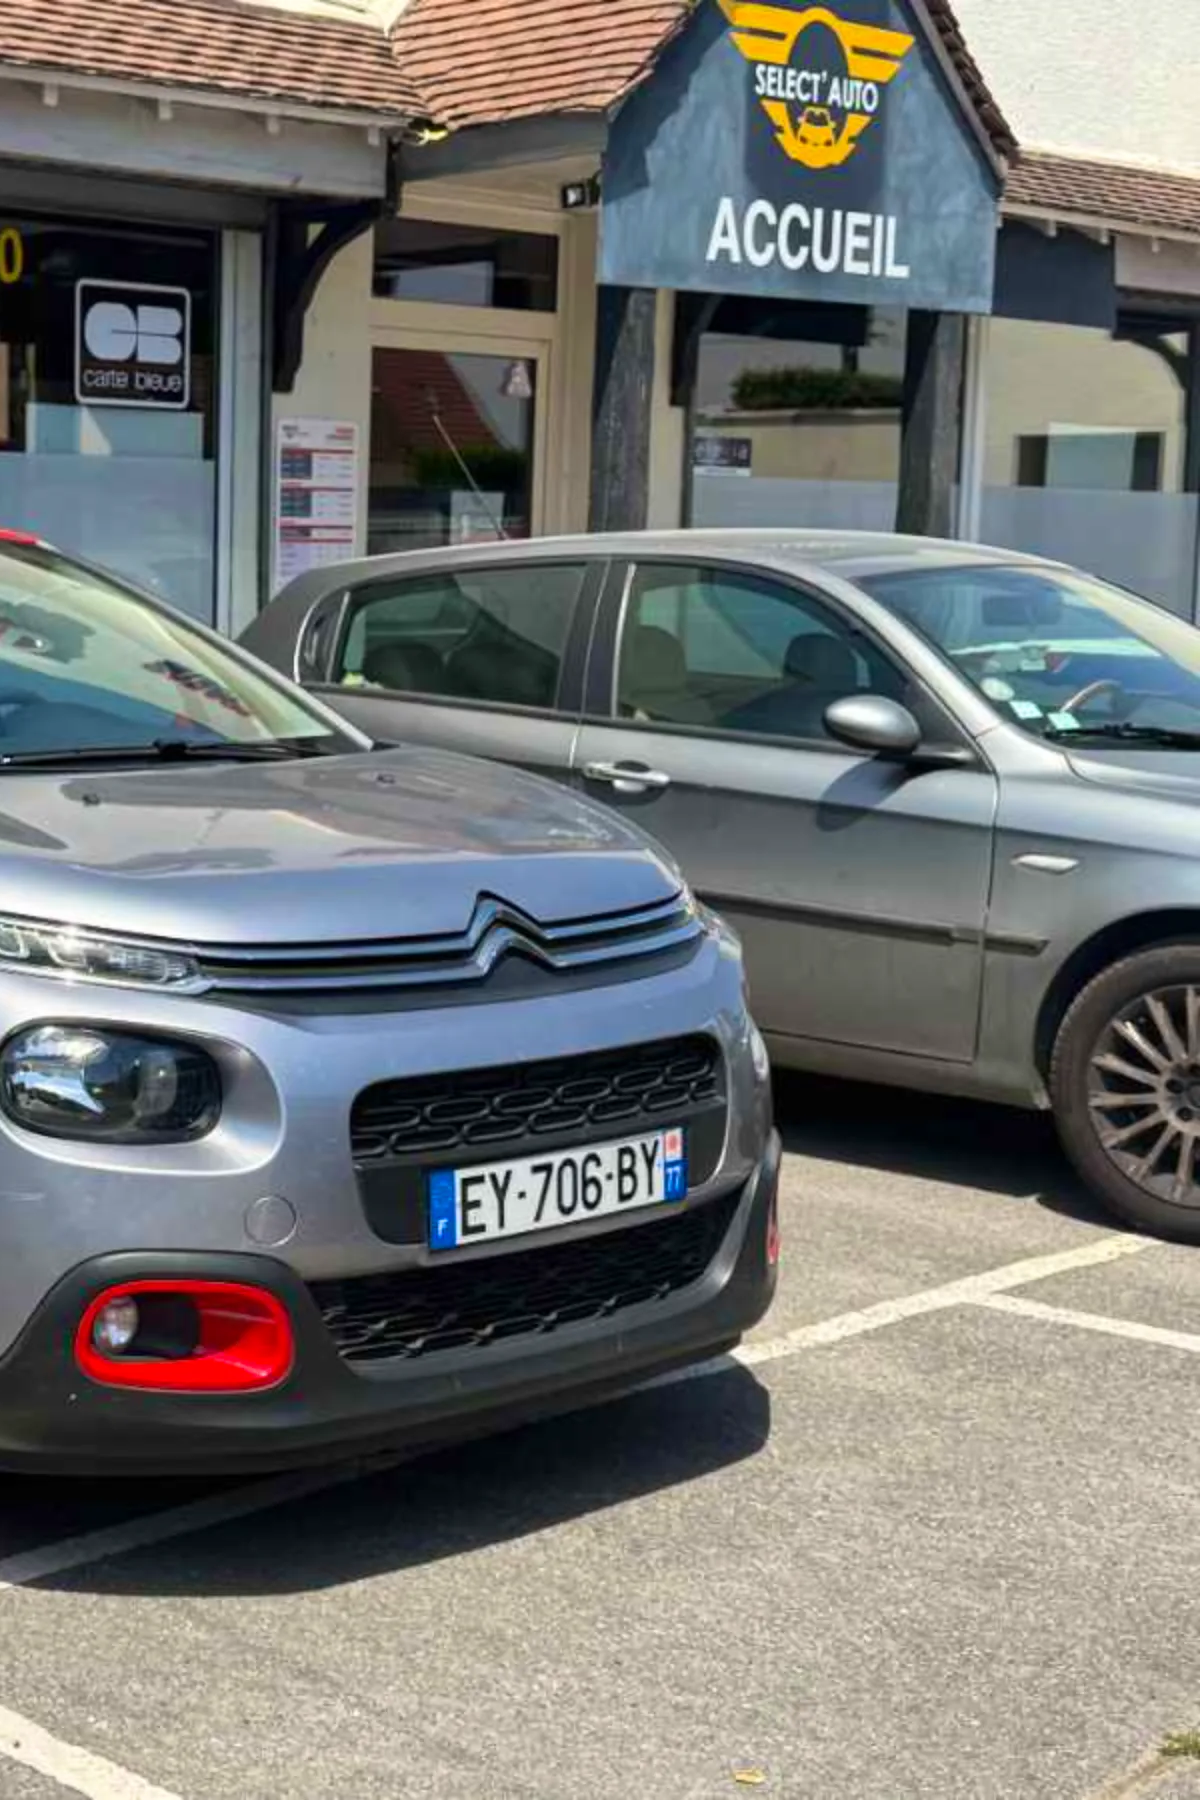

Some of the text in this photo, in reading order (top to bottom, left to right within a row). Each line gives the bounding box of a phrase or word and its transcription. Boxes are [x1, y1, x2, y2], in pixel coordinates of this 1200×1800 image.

[706, 197, 910, 278] ACCUEIL
[436, 1218, 449, 1238] F
[460, 1138, 660, 1237] EY-706-BY
